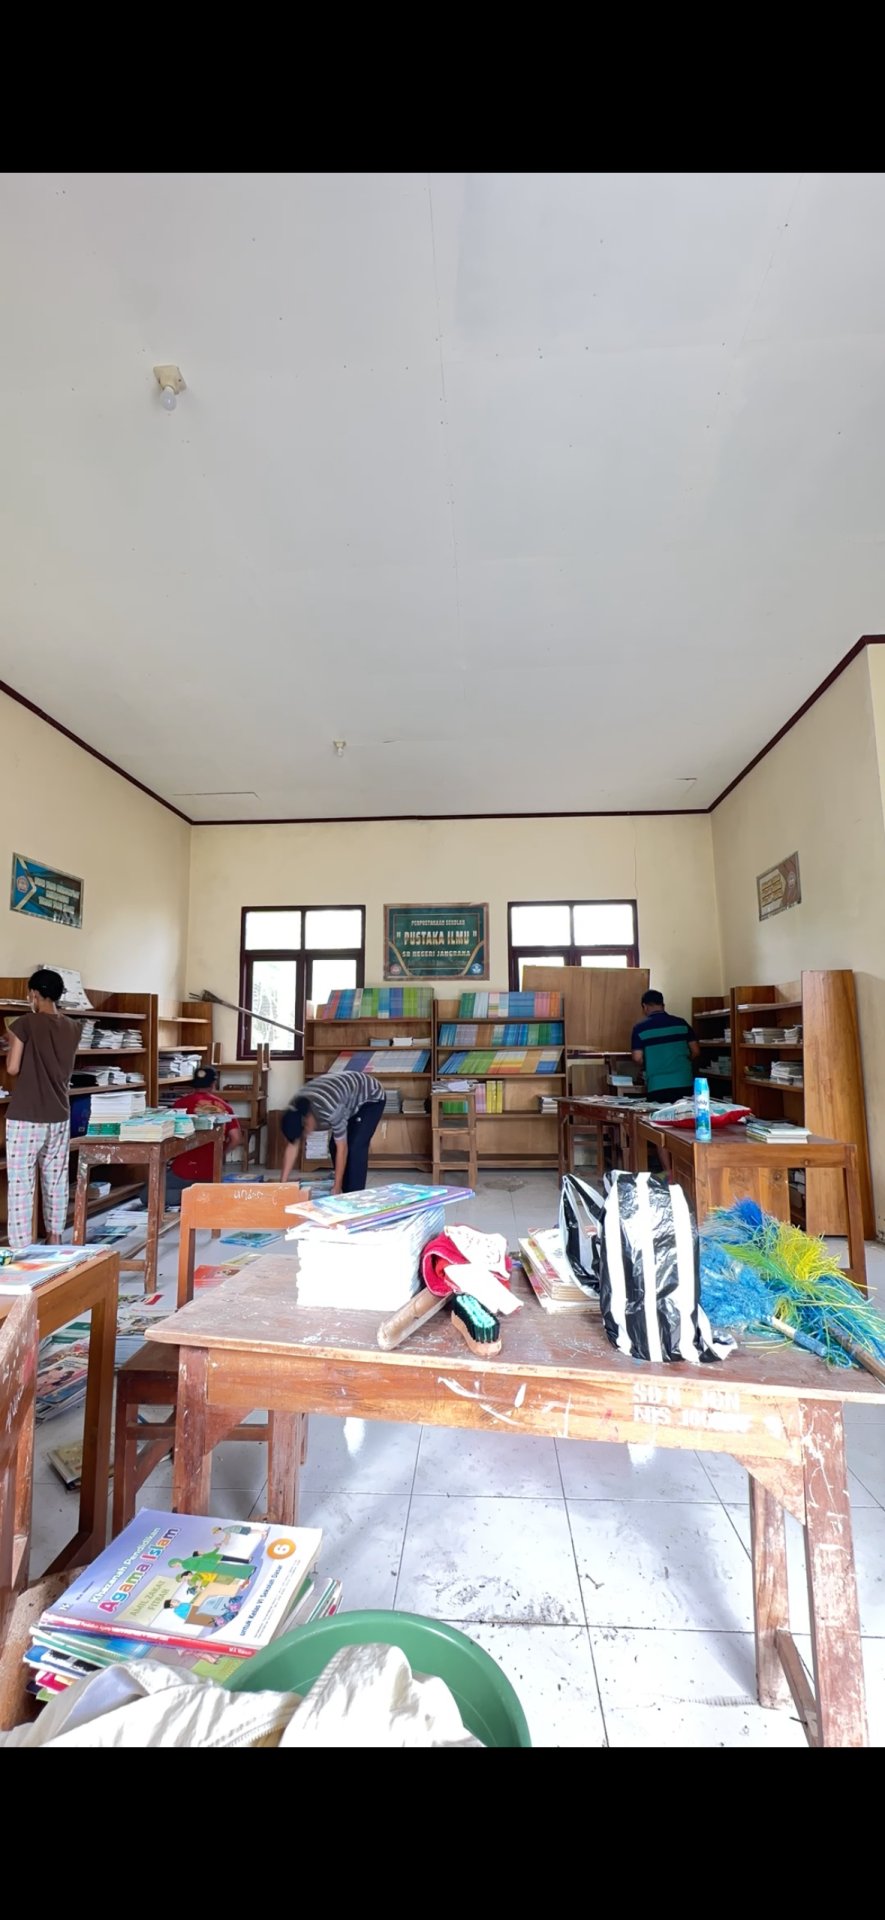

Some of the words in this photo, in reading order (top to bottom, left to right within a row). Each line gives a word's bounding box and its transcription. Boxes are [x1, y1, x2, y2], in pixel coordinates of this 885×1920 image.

[404, 931, 445, 945] PUSTAKA
[447, 931, 470, 945] ILMU
[89, 1565, 128, 1604] Khazanah
[123, 1527, 161, 1566] Pendidikan
[98, 1563, 153, 1614] Agama
[141, 1528, 181, 1561] Islam
[273, 1544, 291, 1555] 6
[130, 1599, 149, 1617] AMIL
[144, 1580, 166, 1600] ZAKAT
[240, 1620, 252, 1636] untuk
[248, 1604, 261, 1619] Kelas
[261, 1579, 274, 1598] Sekolah
